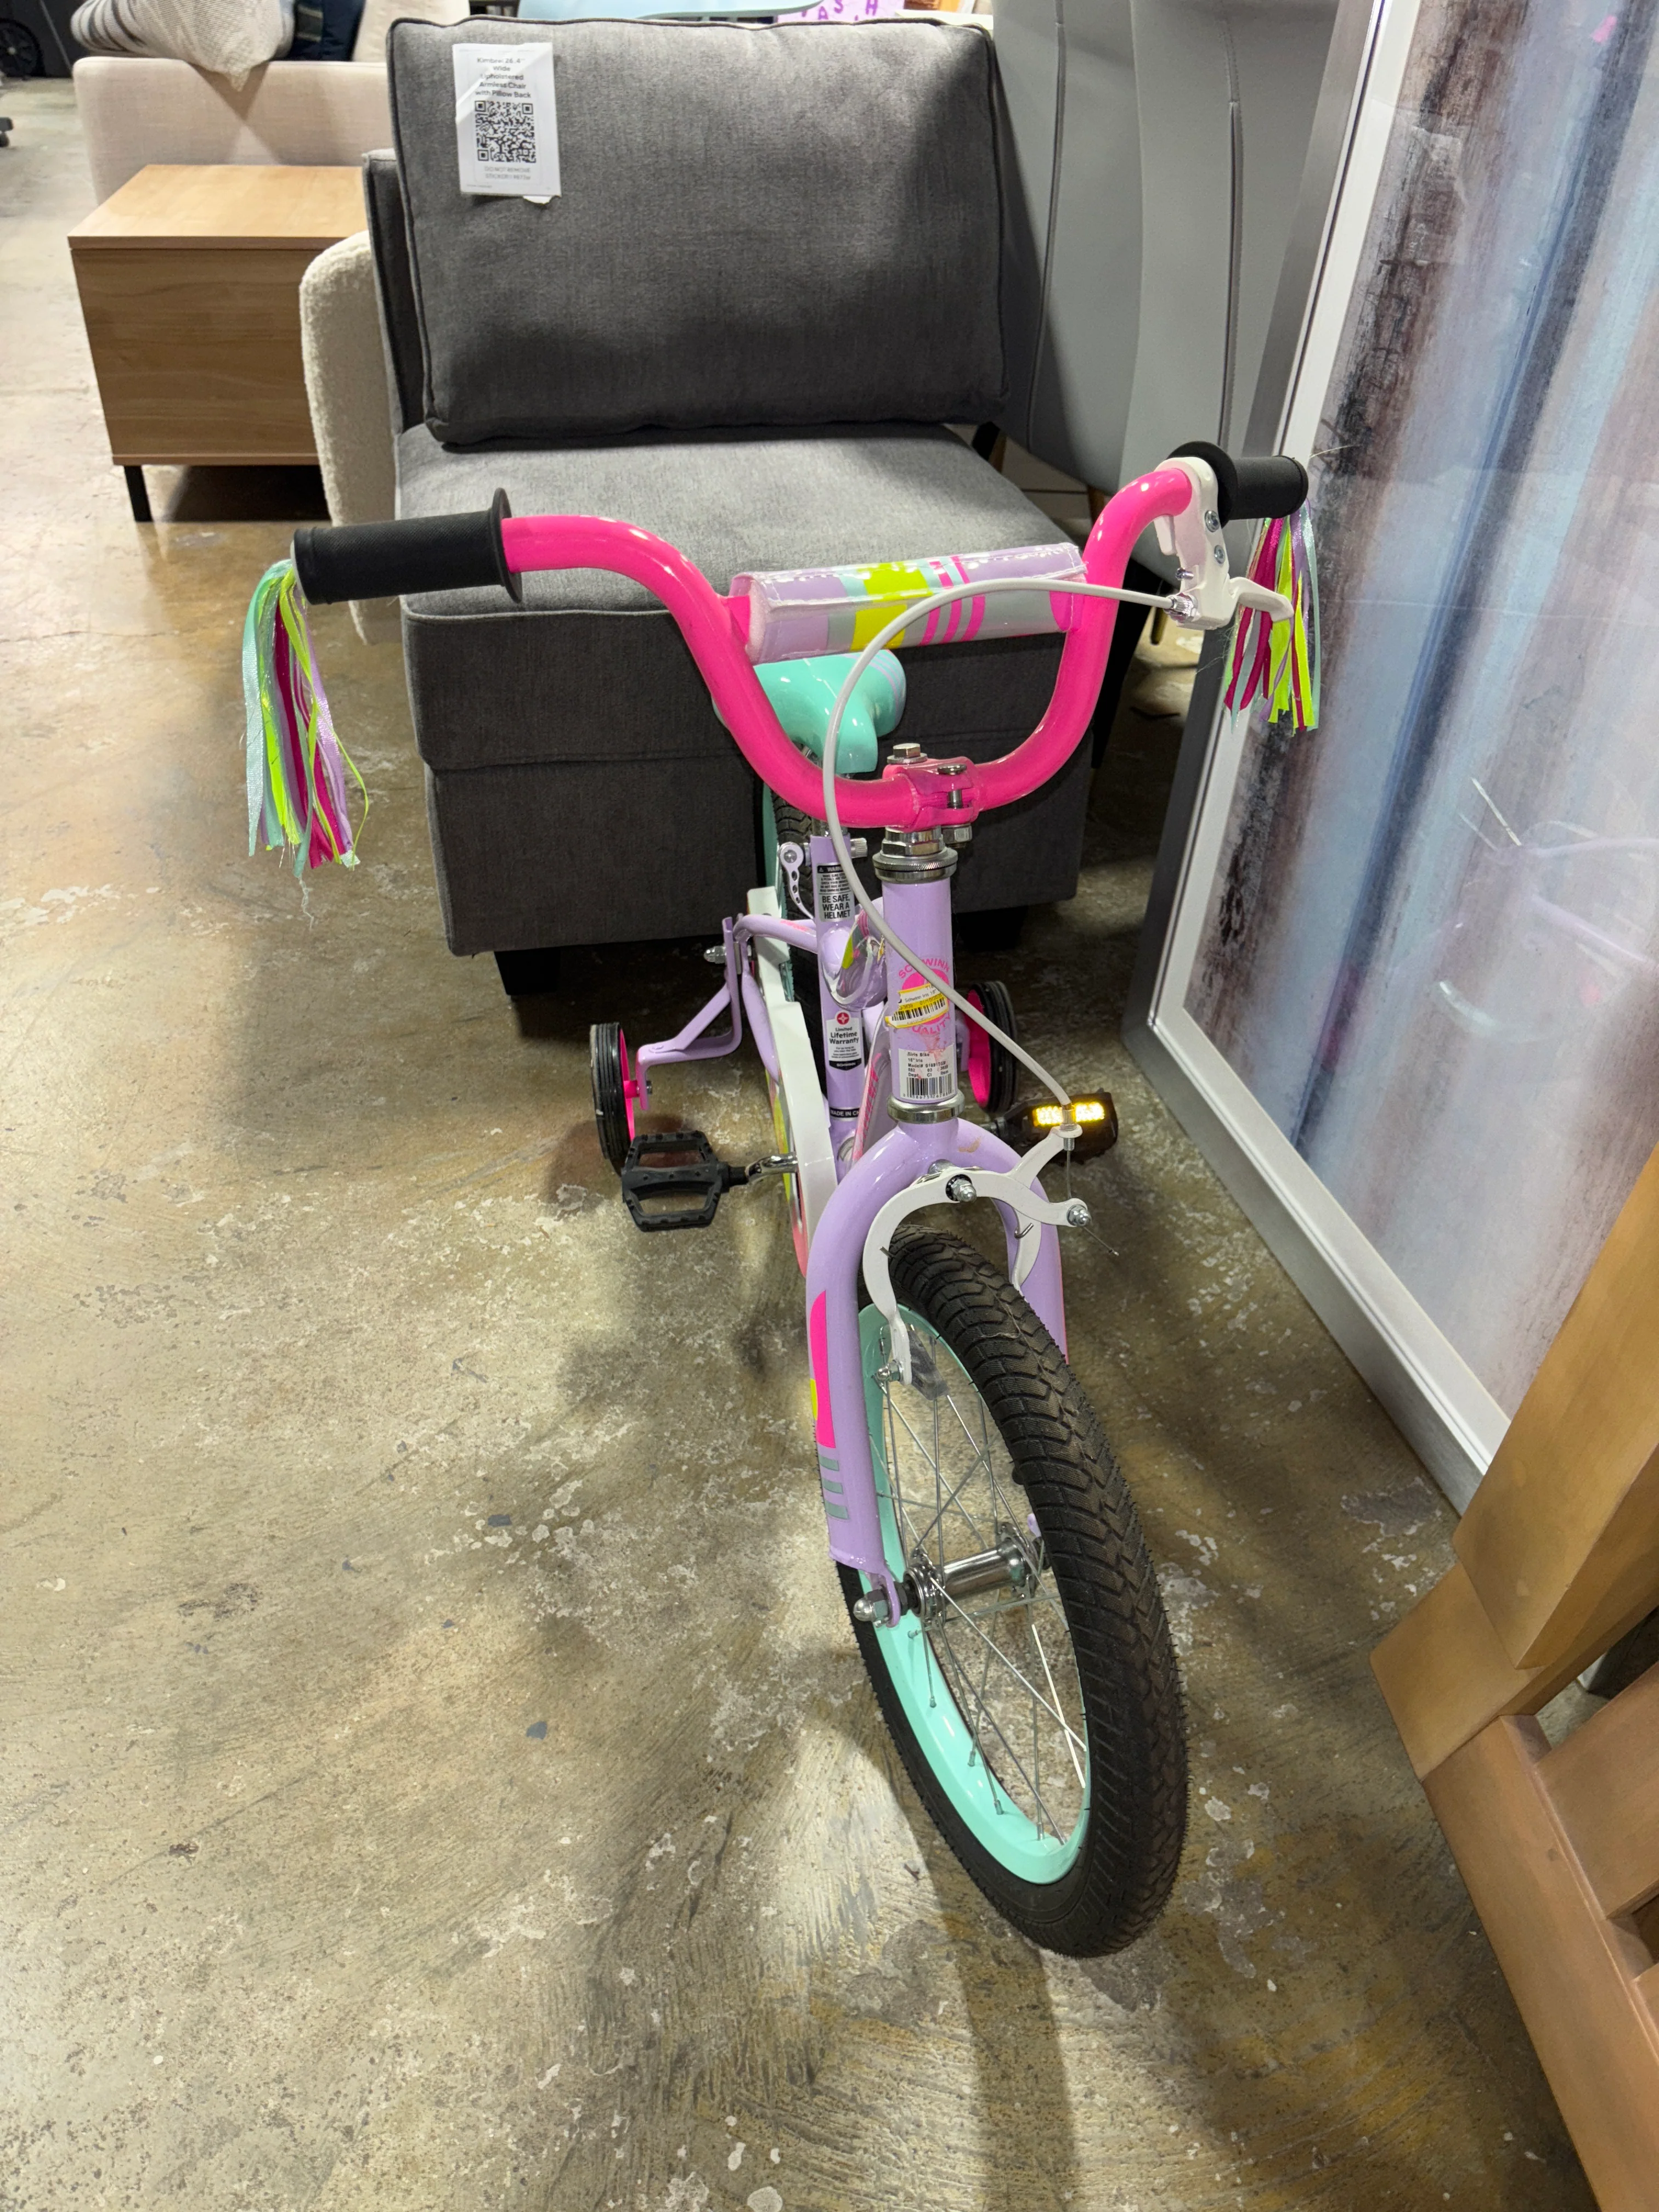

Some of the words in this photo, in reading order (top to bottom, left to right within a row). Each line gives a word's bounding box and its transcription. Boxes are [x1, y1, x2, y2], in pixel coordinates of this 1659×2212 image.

[822, 902, 844, 911] WEAR
[824, 910, 850, 919] HELMET
[908, 1012, 951, 1034] UALITY
